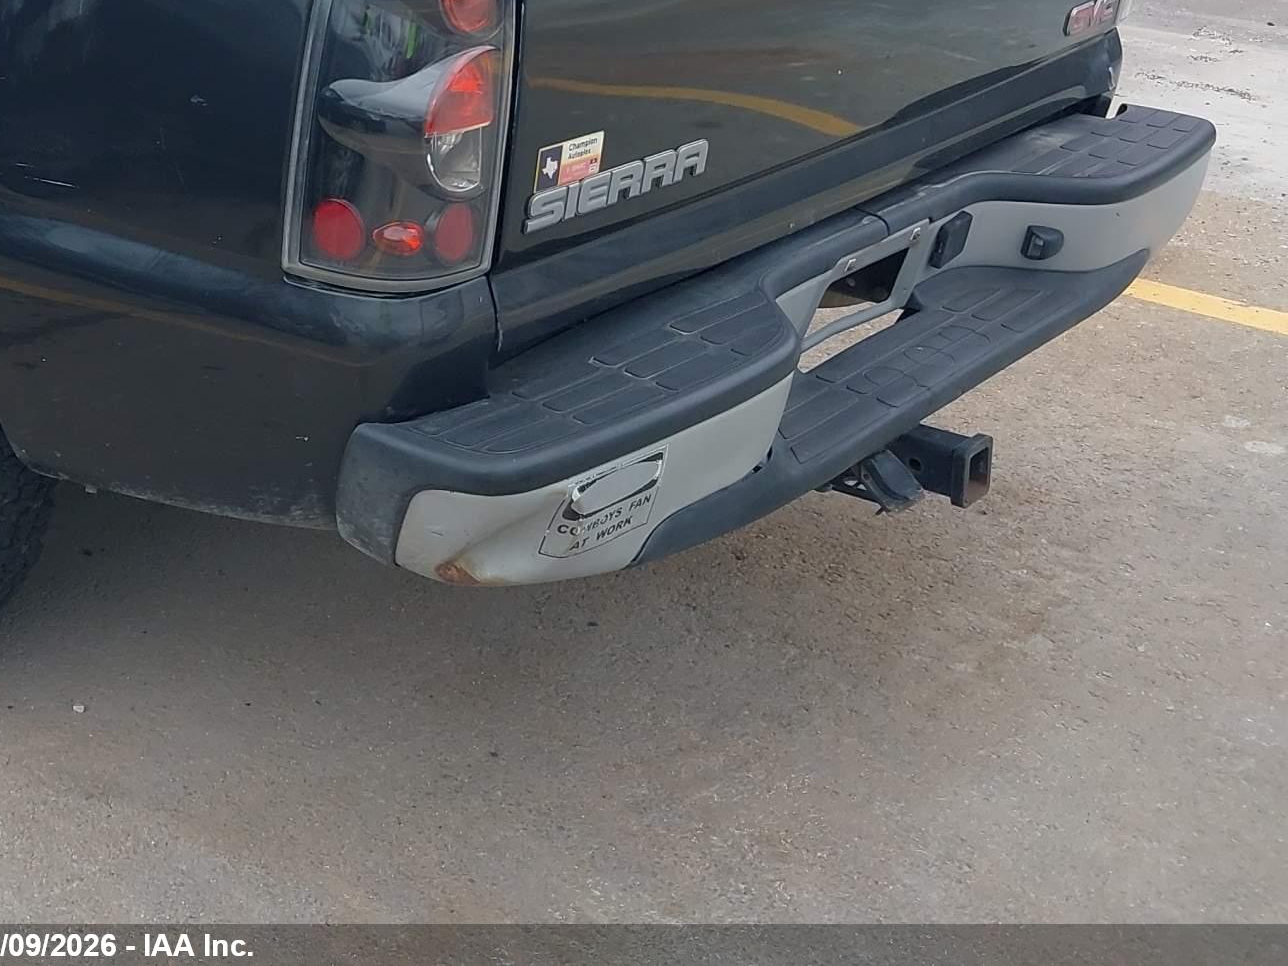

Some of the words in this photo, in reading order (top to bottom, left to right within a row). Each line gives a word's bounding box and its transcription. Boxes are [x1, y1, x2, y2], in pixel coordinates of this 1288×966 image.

[525, 139, 710, 233] SIERRA
[629, 494, 652, 511] FAN
[569, 536, 590, 551] AT
[596, 516, 633, 541] WORK
